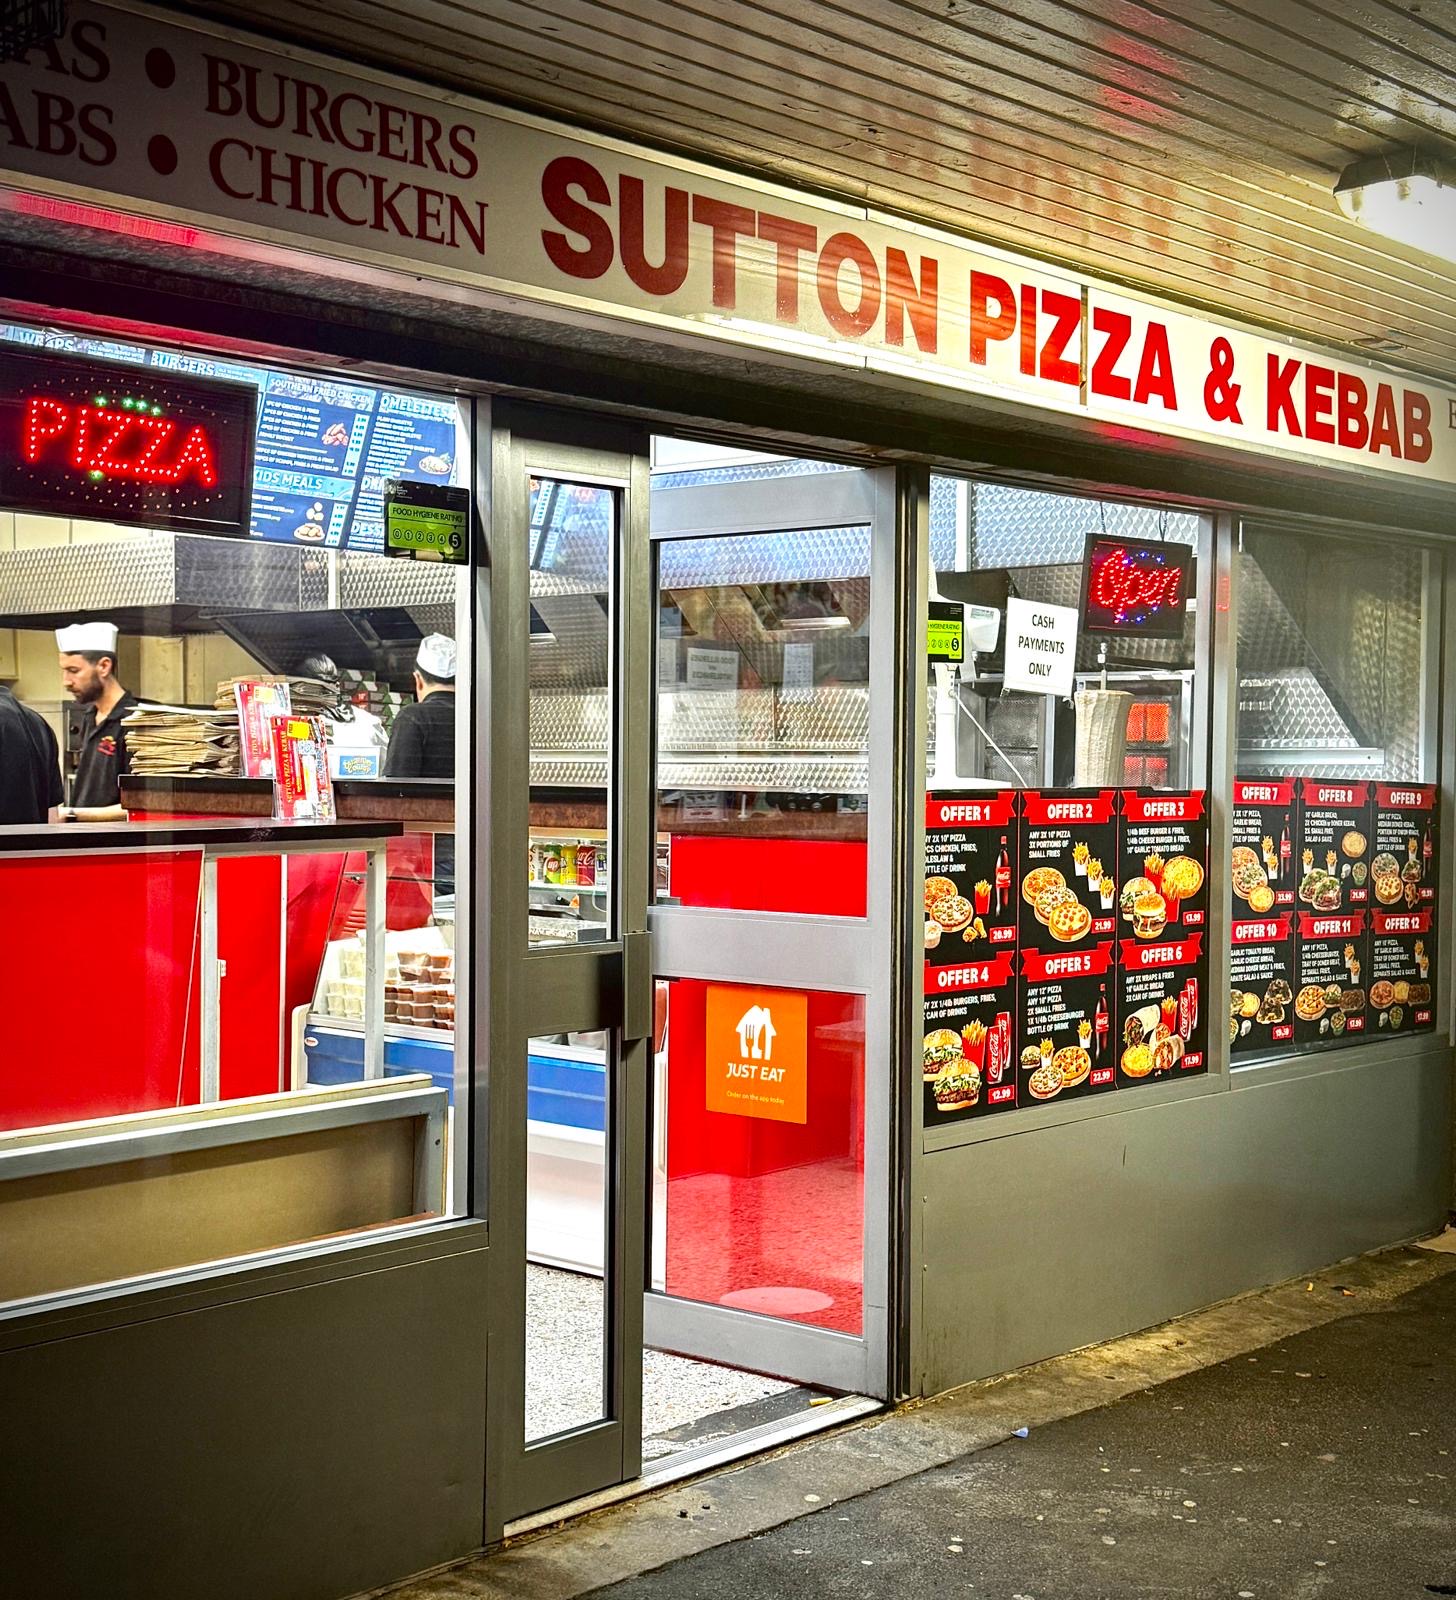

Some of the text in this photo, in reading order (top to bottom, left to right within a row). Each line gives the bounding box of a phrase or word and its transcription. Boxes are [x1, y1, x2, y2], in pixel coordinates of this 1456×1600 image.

[202, 54, 479, 180] BURGERS
[209, 138, 489, 255] CHICKEN
[151, 351, 215, 376] BURGERS
[271, 378, 312, 395] SOUTHERN
[382, 395, 452, 418] OMELETTES
[27, 399, 215, 486] PIZZA
[282, 472, 323, 489] MEALS
[393, 507, 462, 523] FOOD HYGIENE RATING
[452, 534, 458, 546] 5
[1097, 549, 1181, 624] Open
[1032, 614, 1055, 630] CASH
[1018, 635, 1065, 654] PAYMENTS
[1029, 662, 1052, 677] ONLY
[283, 759, 291, 777] PIZZA
[1242, 786, 1278, 800] OFFER 7
[1318, 789, 1353, 802] OFFER 8
[1390, 792, 1422, 805] OFFER 9
[940, 805, 990, 822] OFFER 1
[1047, 804, 1093, 819] OFFER 2
[1143, 802, 1185, 816] OFFER 3
[950, 834, 966, 842] PIZZA
[1029, 831, 1040, 839] ANY
[1056, 830, 1071, 838] PIZZA
[1150, 827, 1167, 835] BURGER
[1029, 841, 1035, 849] 3X
[1036, 840, 1061, 848] PORTIONS
[1138, 836, 1155, 844] CHEESE
[1156, 836, 1173, 844] BURGER
[935, 844, 960, 853] CHICKEN,
[961, 843, 978, 853] FRIES,
[1029, 850, 1060, 858] SMALL FRIES
[1134, 846, 1150, 854] GARLIC
[1170, 844, 1184, 852] BREAD
[941, 864, 948, 872] OF
[949, 864, 966, 872] DRINK
[1095, 921, 1112, 931] 21.99
[1313, 920, 1351, 934] OFFER 11
[1385, 917, 1419, 930] OFFER 12
[993, 929, 1013, 940] 20.99
[1236, 923, 1277, 939] OFFER 10
[1141, 946, 1182, 964] OFFER 6
[1045, 956, 1091, 974] OFFER 5
[938, 966, 989, 987] OFFER 4
[1126, 976, 1135, 984] ANY
[1142, 973, 1157, 982] WRAPS
[1162, 971, 1174, 979] FRIES
[1027, 988, 1038, 997] ANY
[1047, 985, 1062, 994] PIZZA
[1133, 983, 1149, 992] GARLIC
[1150, 981, 1164, 990] BREAD
[931, 1001, 938, 1009] 2X
[953, 995, 980, 1007] BURGERS,
[980, 993, 996, 1003] FRIES,
[1027, 998, 1038, 1006] ANY
[1047, 995, 1062, 1003] PIZZA
[1133, 993, 1141, 1002] CAN
[1149, 990, 1164, 999] DRINKS
[926, 1007, 968, 1020] CAN OF DRINKS
[1027, 1003, 1066, 1016] 2X SMALL FRIES
[1028, 1017, 1034, 1025] 1X
[1047, 1010, 1085, 1022] CHEESEBURGER
[1027, 1022, 1069, 1035] BOTTLE OF DRINK
[726, 1063, 786, 1082] JUST EAT
[991, 1088, 1011, 1100] 12.99
